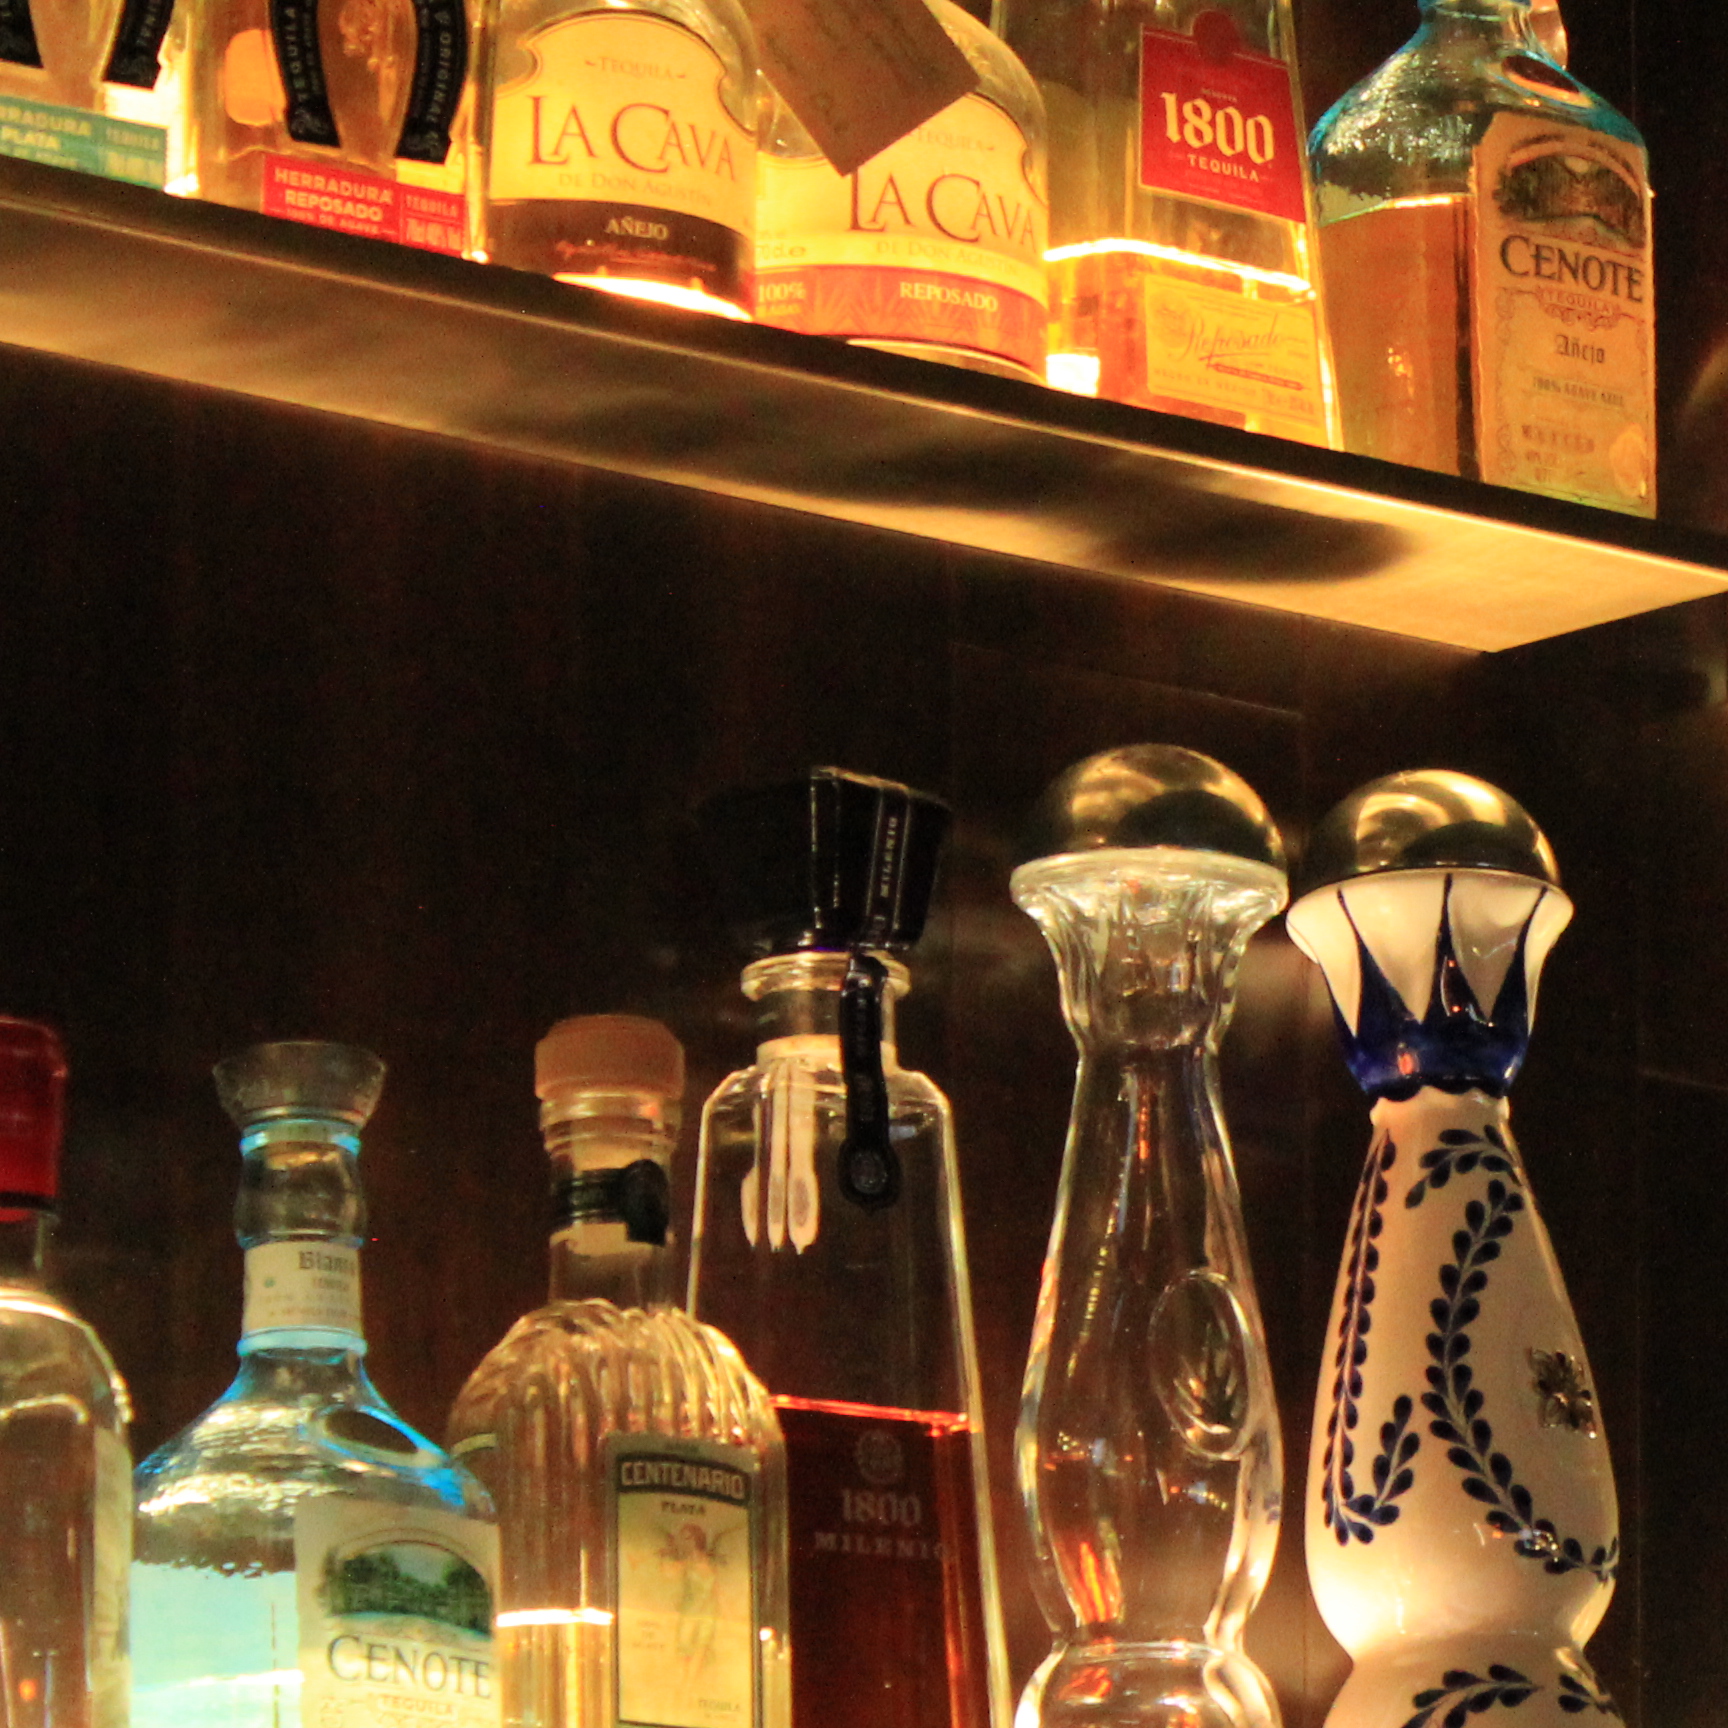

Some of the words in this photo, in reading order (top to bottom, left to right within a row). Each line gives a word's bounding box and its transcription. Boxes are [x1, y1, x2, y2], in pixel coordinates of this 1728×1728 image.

[527, 95, 599, 166] LA
[610, 102, 736, 183] CAVA
[1160, 92, 1274, 165] 1800
[274, 167, 394, 206] HERRADURA
[1187, 154, 1259, 183] TEQUILA
[284, 189, 384, 222] REPOSADO
[926, 173, 1038, 254] CAVA
[605, 216, 669, 241] AÑEJO
[1501, 235, 1645, 302] CENOTE
[758, 281, 807, 303] 100%
[900, 281, 998, 312] REPOSADO
[621, 1461, 746, 1499] CENTENARIO
[841, 1488, 921, 1527] 1800
[814, 1531, 945, 1559] MILENIO
[326, 1634, 492, 1699] CENOTE
[379, 1694, 454, 1717] TEQUILA
